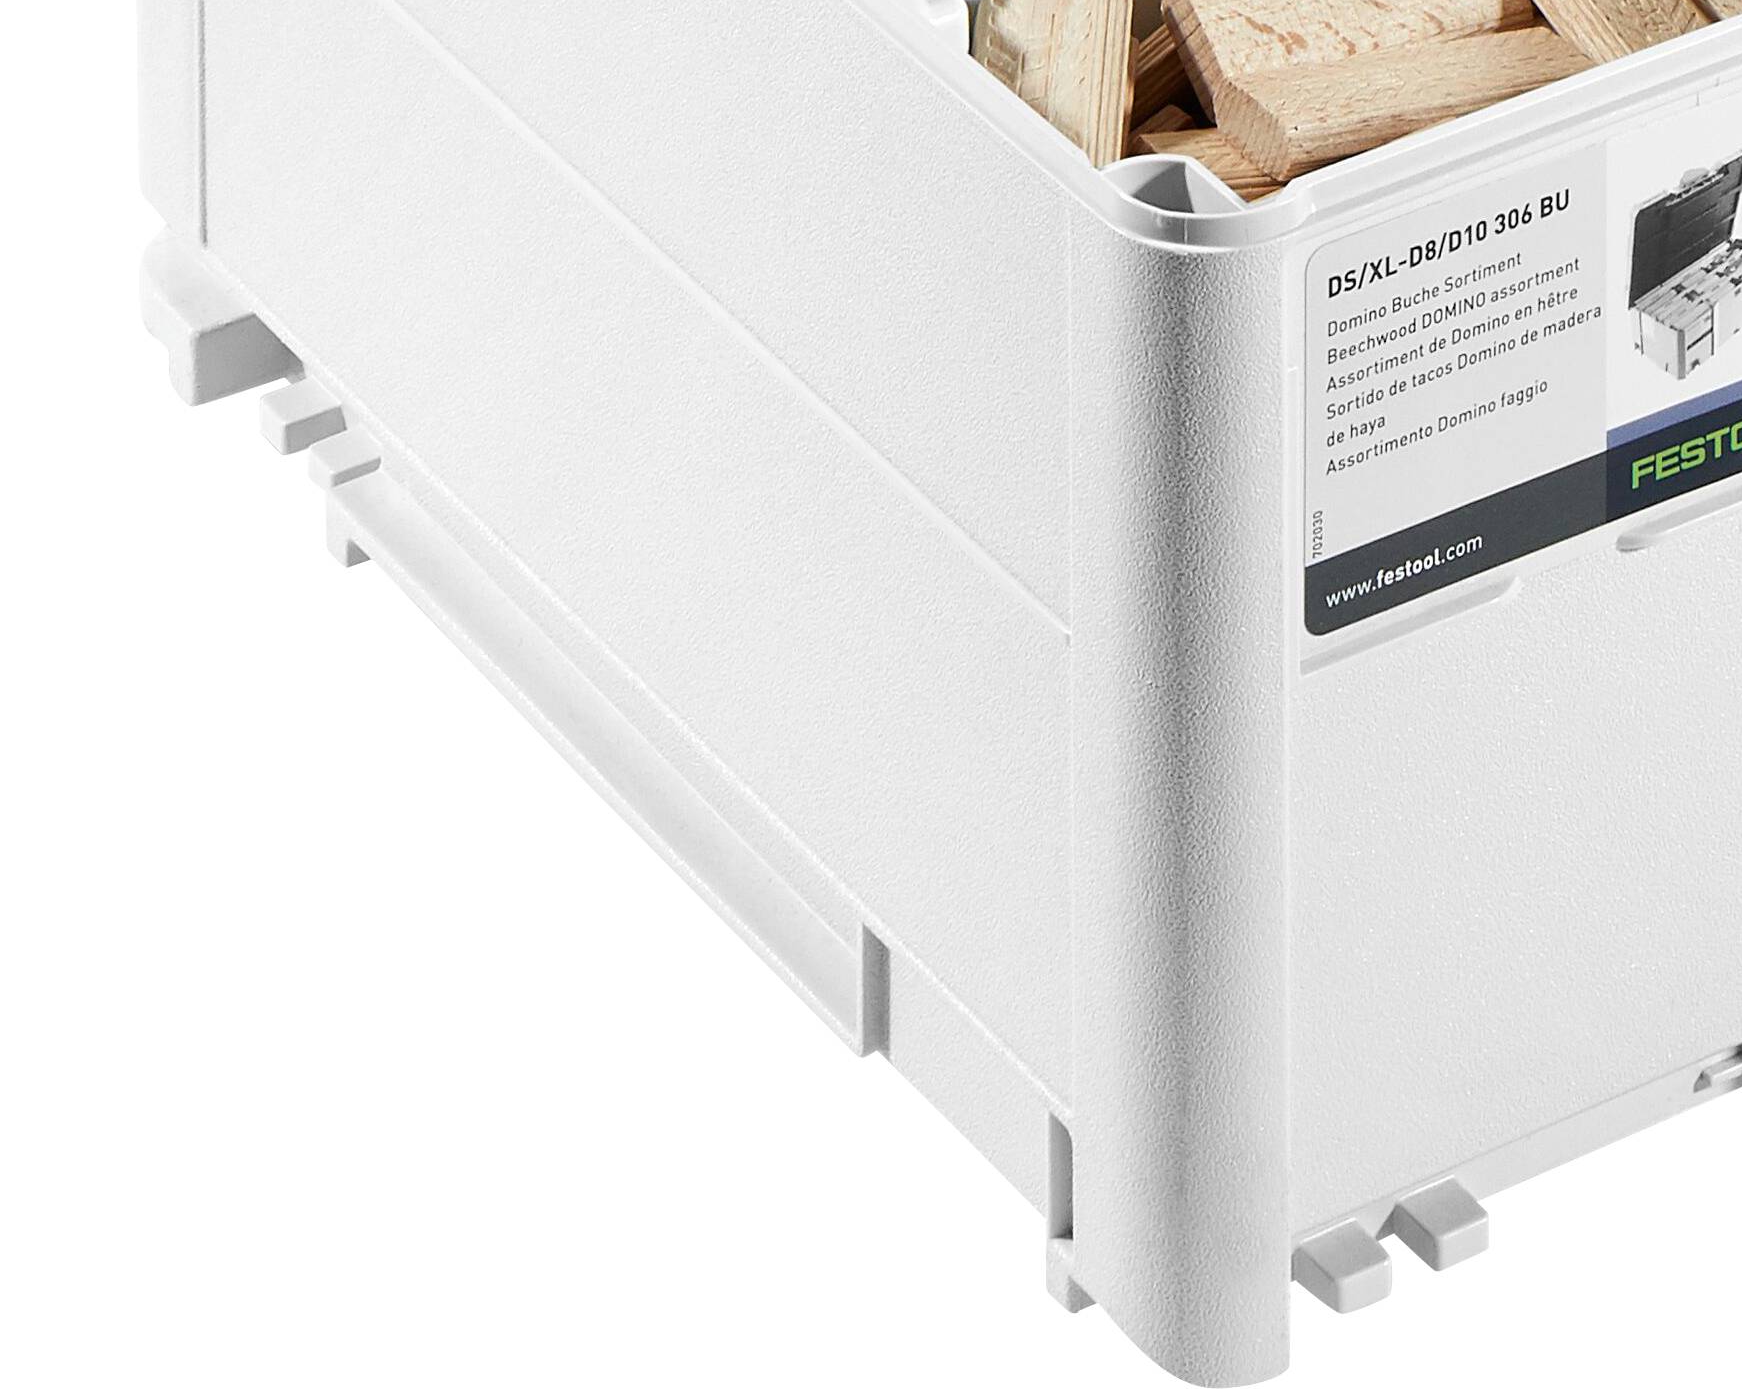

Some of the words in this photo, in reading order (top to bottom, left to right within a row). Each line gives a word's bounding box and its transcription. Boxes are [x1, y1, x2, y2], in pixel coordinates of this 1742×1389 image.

[1328, 220, 1488, 298] DS/XL-D8/D10
[1494, 203, 1532, 236] 306
[1539, 189, 1570, 219] BU
[1326, 346, 1425, 393] Assortiment
[1429, 337, 1447, 354] de
[1451, 314, 1510, 346] Domino
[1515, 305, 1532, 321] en
[1537, 288, 1578, 313] hêtre
[1328, 305, 1387, 337] Domino
[1392, 285, 1440, 314] Buche
[1444, 252, 1522, 293] Sortiment
[1328, 319, 1417, 365] Beechwood
[1422, 292, 1486, 330] DOMINO
[1490, 257, 1580, 303] assortment
[1326, 387, 1384, 420] Sortido
[1389, 380, 1407, 397] de
[1412, 362, 1453, 389] tacos
[1457, 337, 1516, 370] Domino
[1520, 329, 1538, 346] de
[1543, 306, 1602, 338] madera
[1326, 425, 1433, 476] Assortimento
[1438, 401, 1496, 433] Domino
[1500, 380, 1548, 410] faggio
[1326, 430, 1345, 448] de
[1350, 415, 1386, 441] haya
[1312, 510, 1323, 559] 702030
[1326, 533, 1483, 608] www.festool.com
